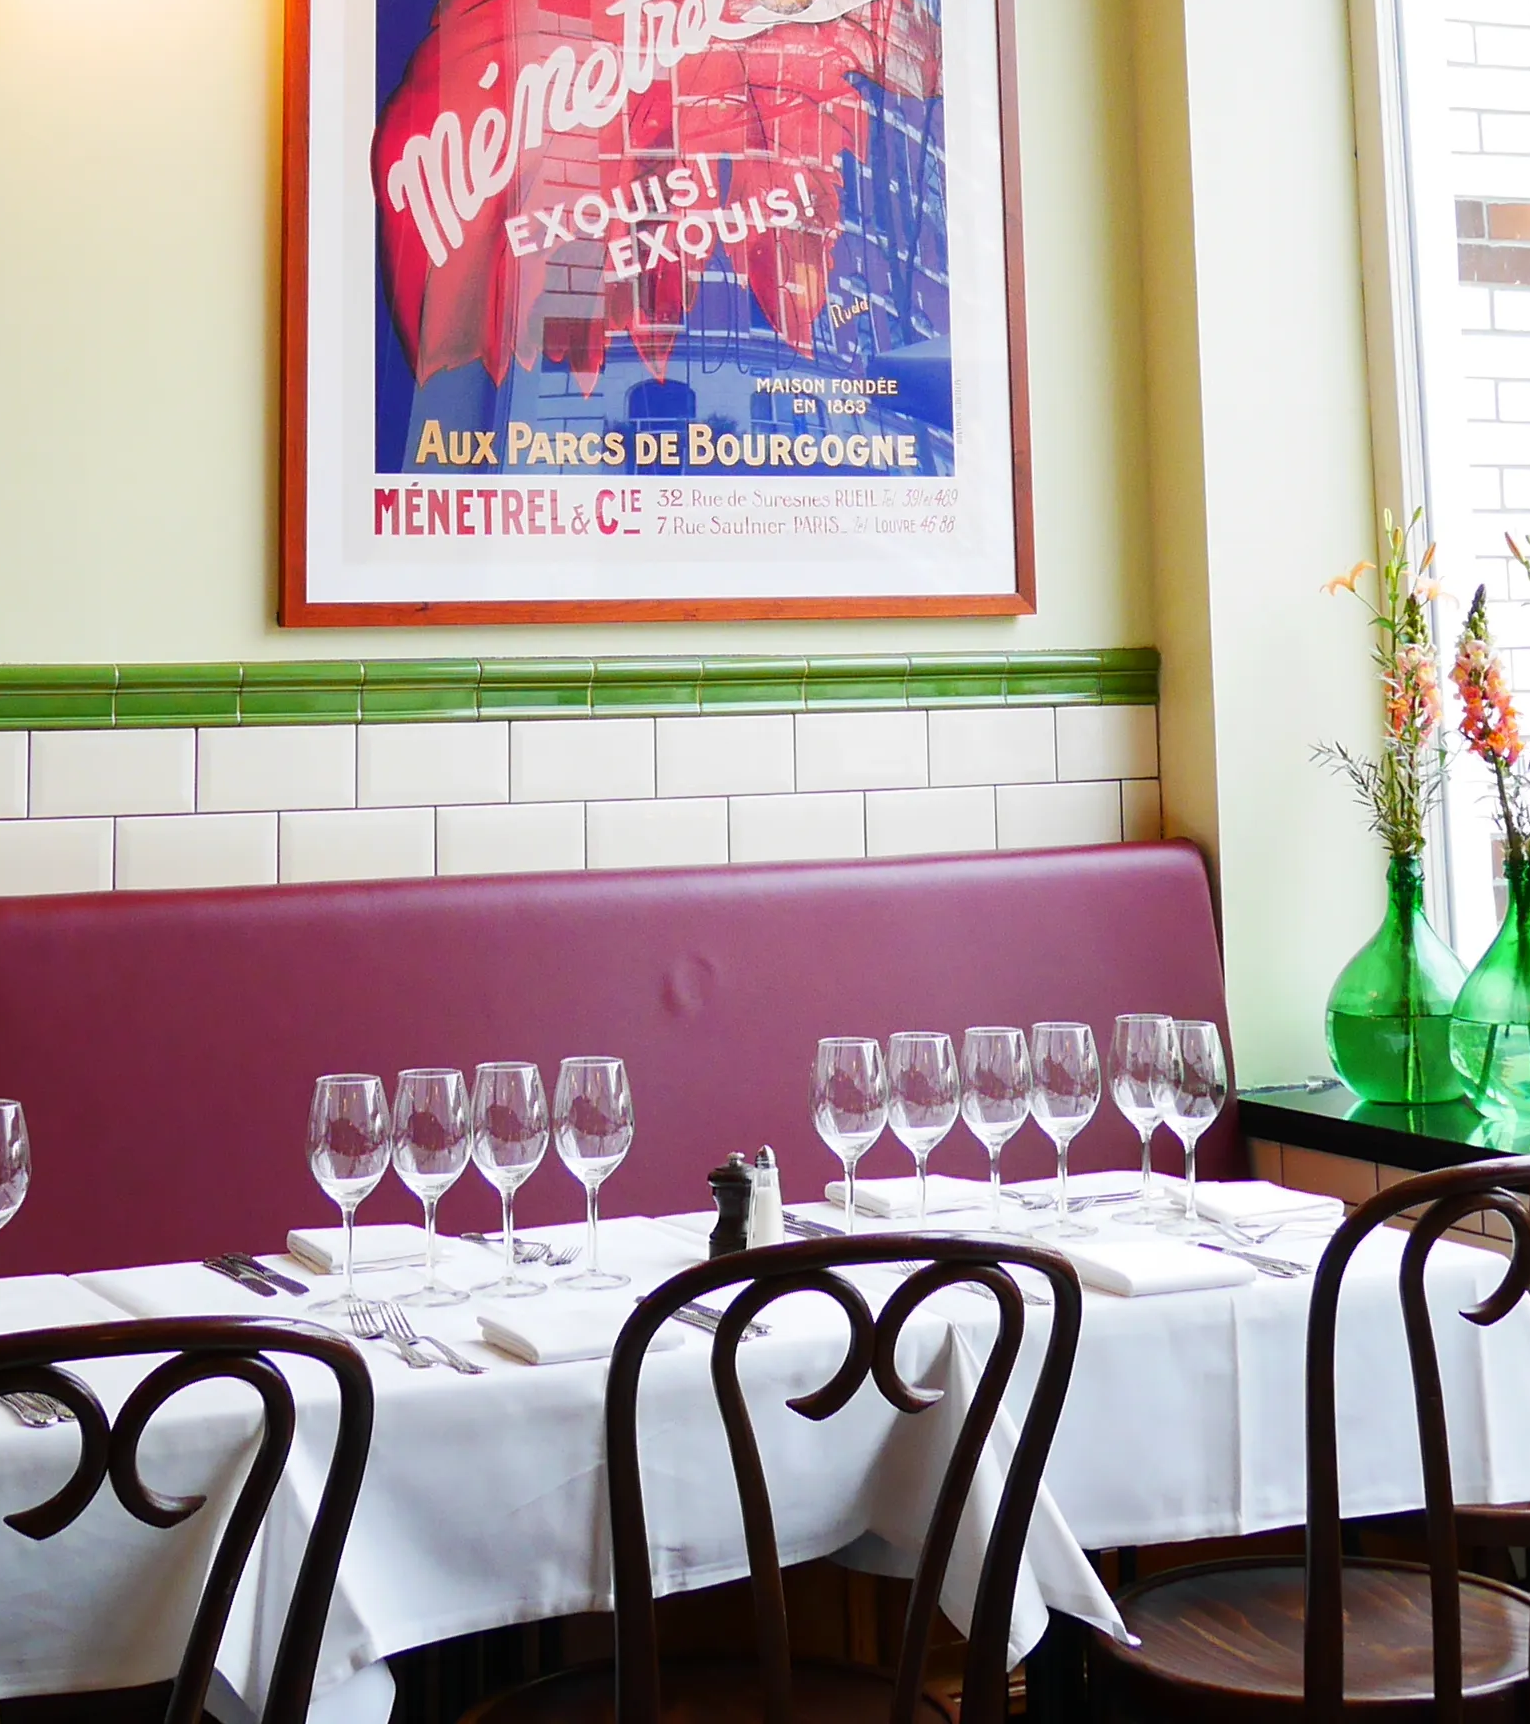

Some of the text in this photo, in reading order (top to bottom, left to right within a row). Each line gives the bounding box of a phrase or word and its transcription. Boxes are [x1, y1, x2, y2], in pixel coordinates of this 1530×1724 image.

[504, 153, 718, 258] EXQUIS!
[608, 172, 815, 280] EXQUIS!
[756, 377, 898, 395] MAISON FONDÉE
[793, 399, 867, 414] EN 1883
[691, 489, 723, 507] Rue
[727, 489, 747, 507] de
[752, 489, 831, 508] Suresnes
[835, 489, 877, 507] RUEIL
[673, 516, 706, 534] Rue
